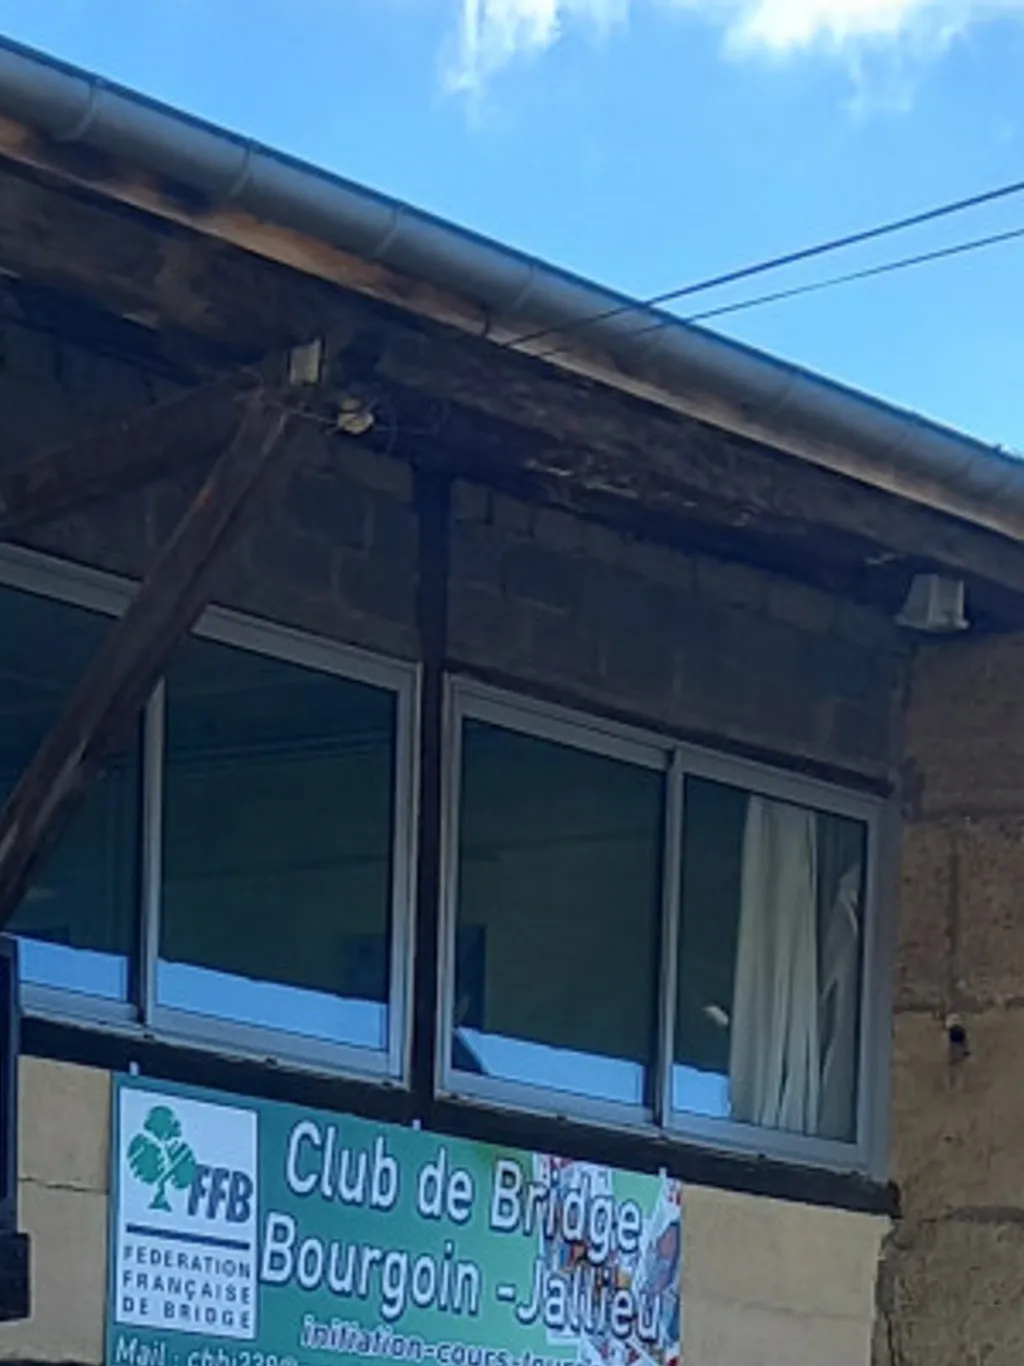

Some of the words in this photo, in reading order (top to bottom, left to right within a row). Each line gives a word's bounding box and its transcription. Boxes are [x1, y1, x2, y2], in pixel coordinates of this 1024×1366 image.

[186, 1163, 254, 1223] FFB
[286, 1120, 399, 1208] Club
[418, 1147, 474, 1222] de
[490, 1159, 643, 1263] Bridge
[122, 1269, 251, 1305] FRANÇAISE
[260, 1212, 480, 1321] Bourgoin
[122, 1296, 149, 1315] DE
[163, 1301, 251, 1329] BRIDGE
[114, 1336, 166, 1366] Mail
